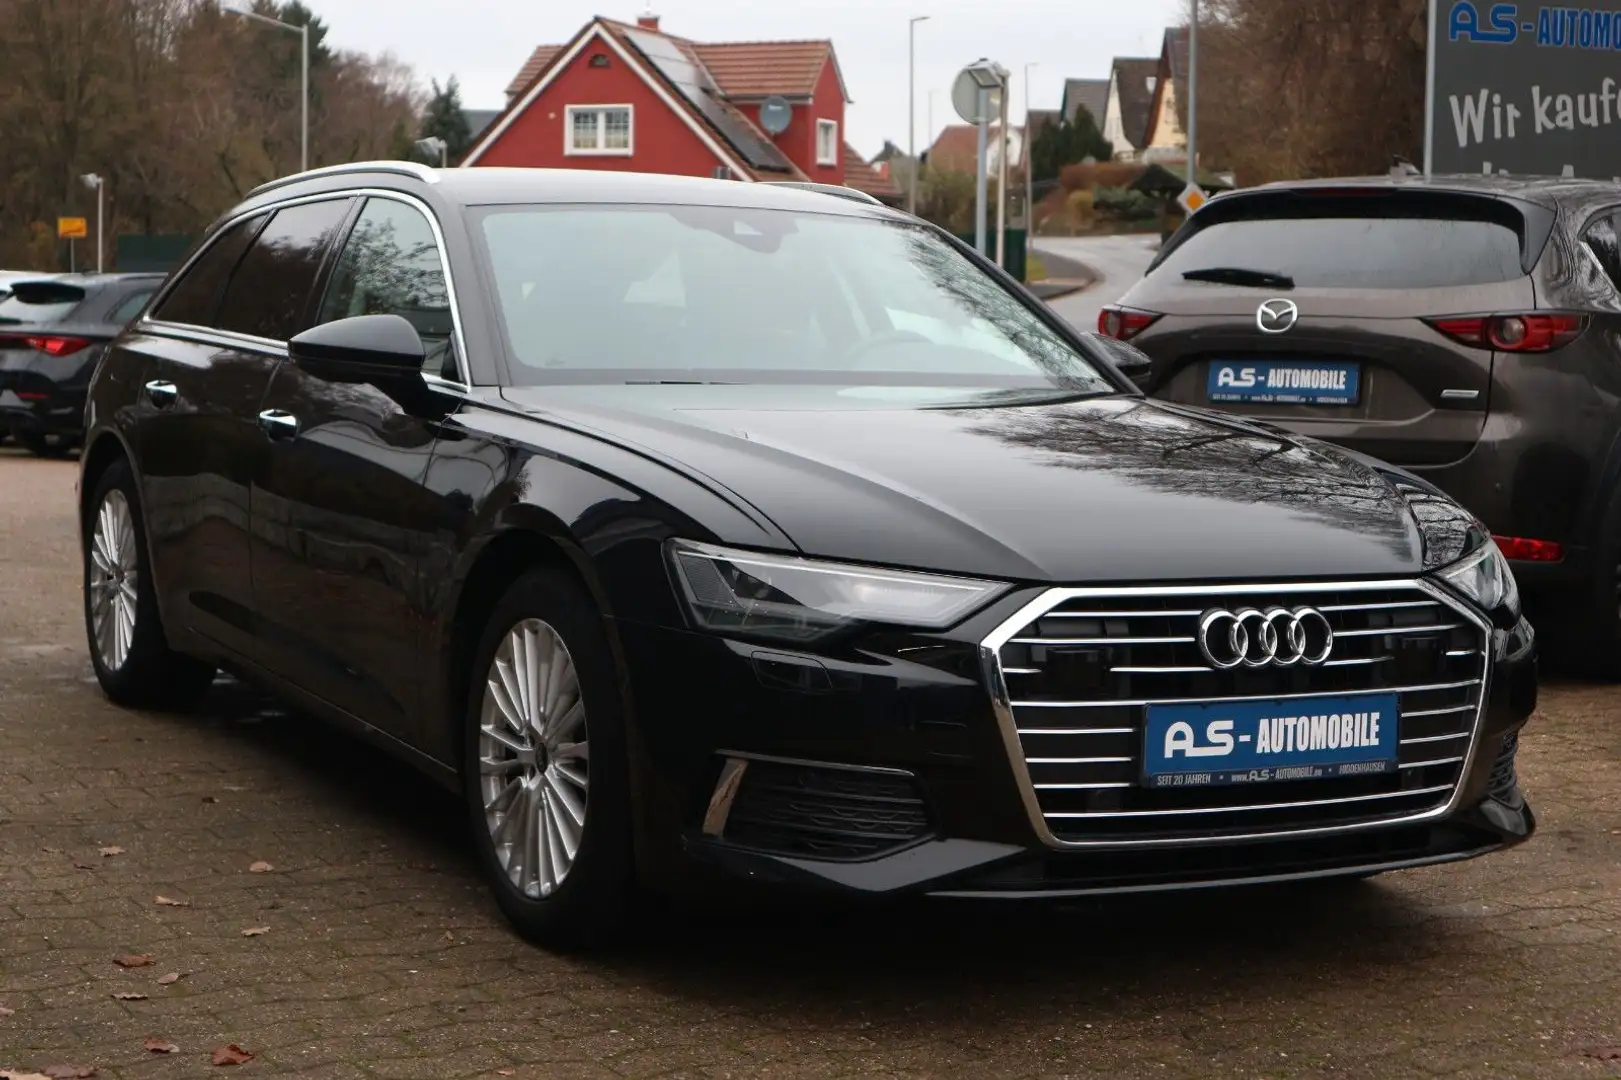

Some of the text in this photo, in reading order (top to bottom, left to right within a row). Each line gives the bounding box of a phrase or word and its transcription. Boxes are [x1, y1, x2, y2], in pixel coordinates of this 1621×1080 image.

[1449, 88, 1521, 148] Wir
[1217, 366, 1347, 390] AS-AUTOMOBILE
[1164, 712, 1381, 758] AS-AUTOMOBILE
[1157, 775, 1172, 786] SEIT
[1173, 775, 1183, 786] 20
[1184, 774, 1211, 785] JAHREN
